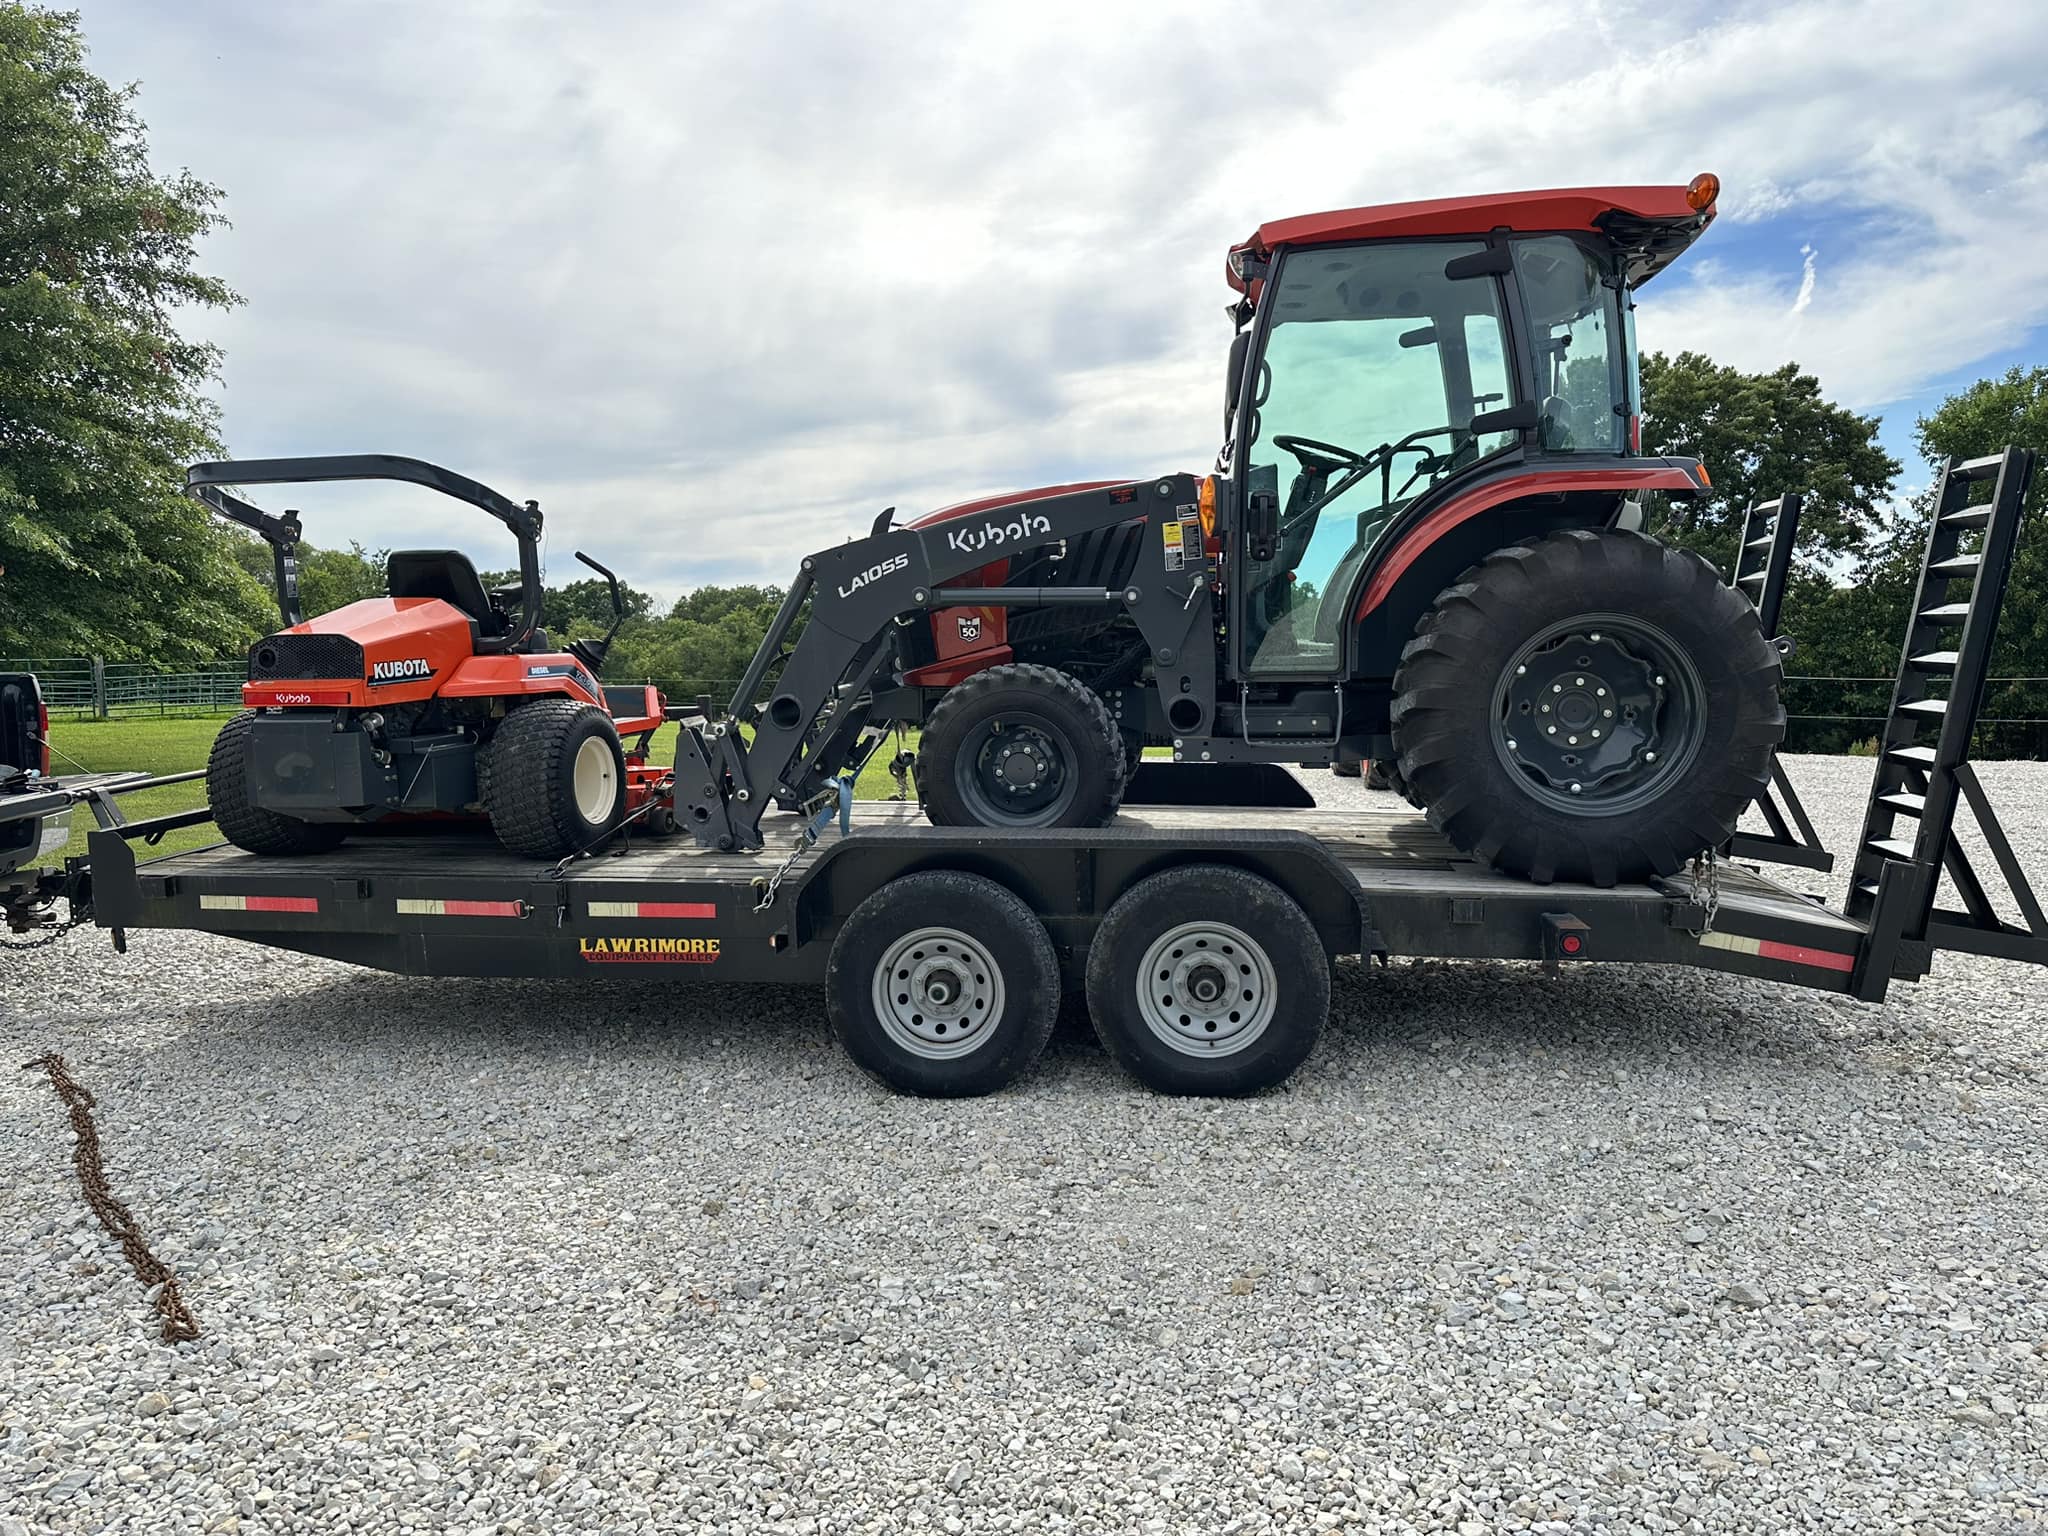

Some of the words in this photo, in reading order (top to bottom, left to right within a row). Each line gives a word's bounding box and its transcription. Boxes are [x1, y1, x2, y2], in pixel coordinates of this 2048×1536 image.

[947, 513, 1051, 553] Kubota
[838, 553, 909, 599] LA1055
[962, 627, 976, 637] 50
[374, 659, 430, 679] KUBOTA
[275, 693, 311, 704] Kubota
[580, 938, 720, 952] LAWRIMORE
[589, 953, 657, 961] EQUIPMENT
[664, 953, 713, 961] TRAILER
